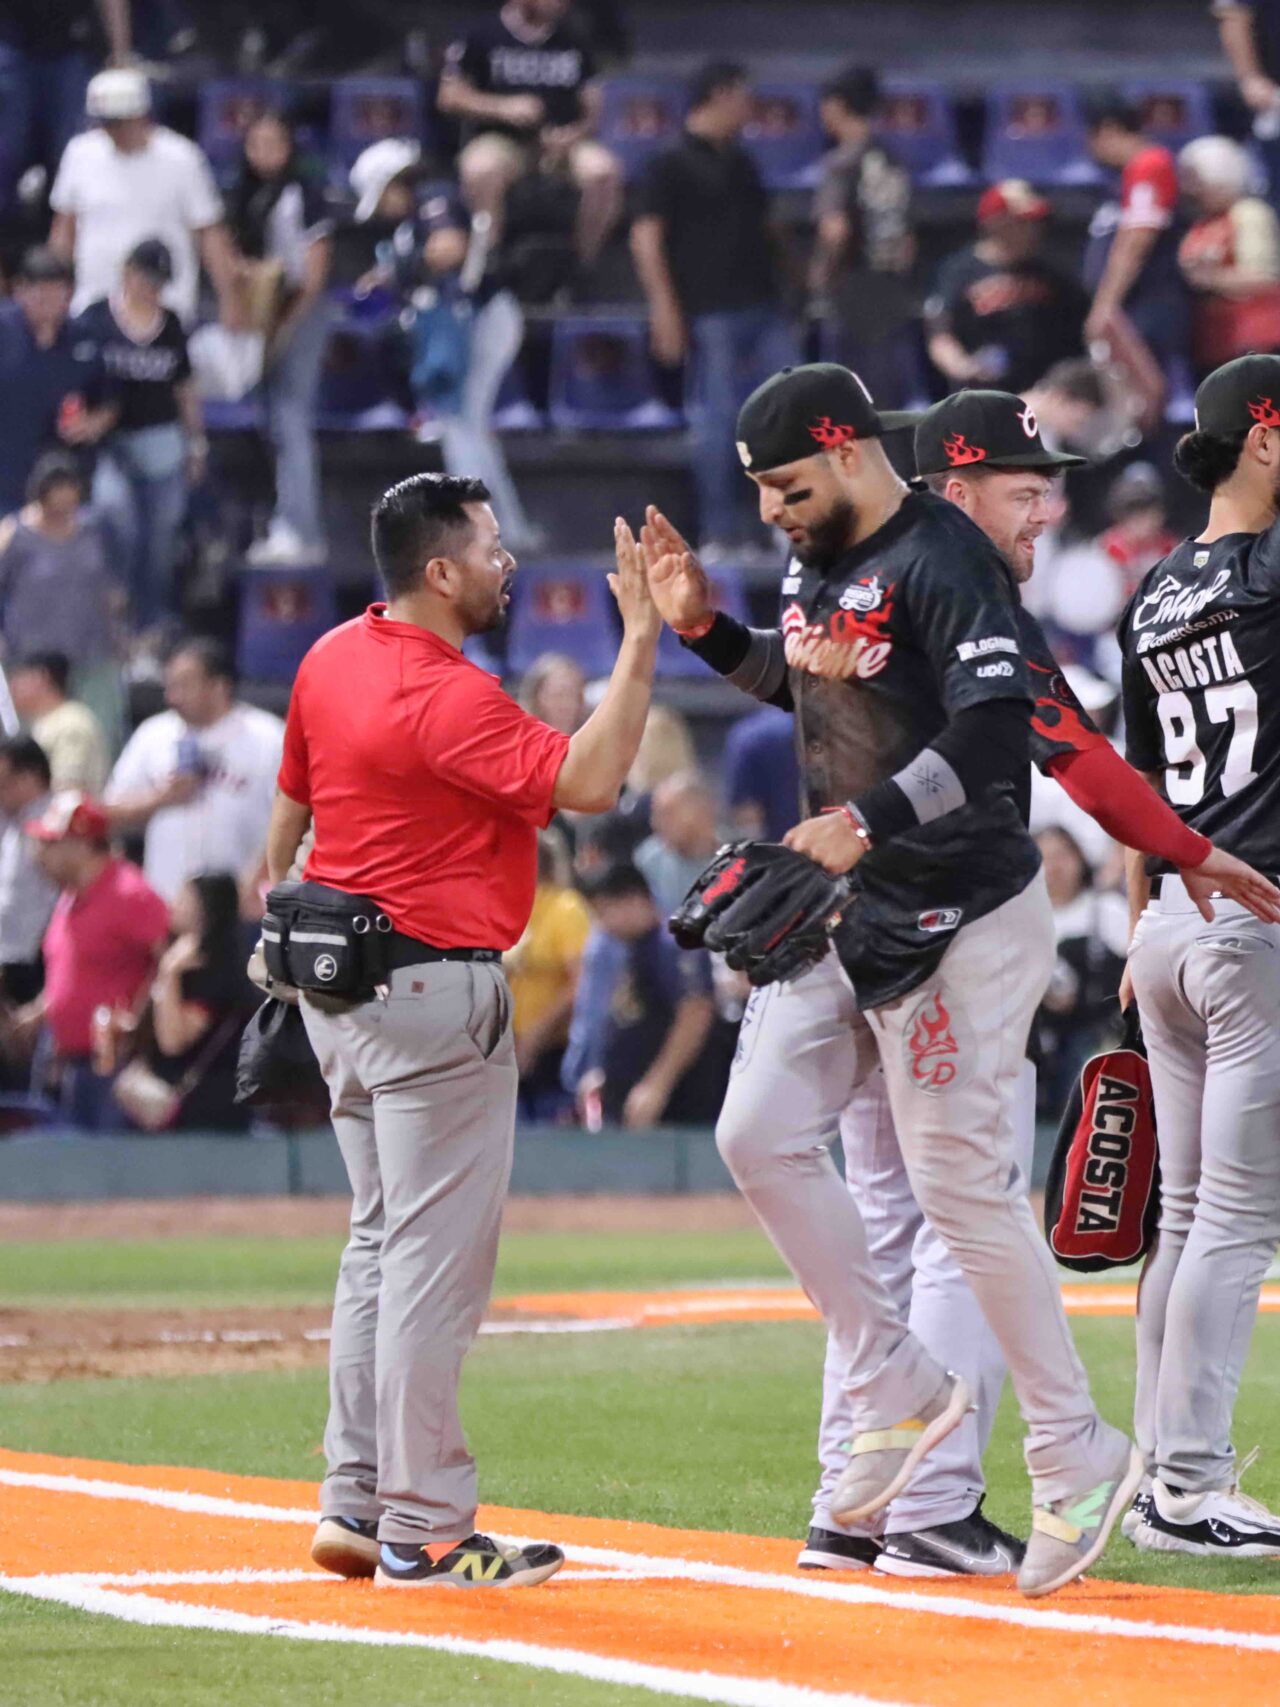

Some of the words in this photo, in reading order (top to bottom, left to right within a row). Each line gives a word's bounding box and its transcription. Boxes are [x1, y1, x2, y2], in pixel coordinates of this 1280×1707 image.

[1141, 630, 1245, 693] ACOSTA
[1157, 679, 1259, 807] 97
[1075, 1074, 1140, 1234] ACOSTA
